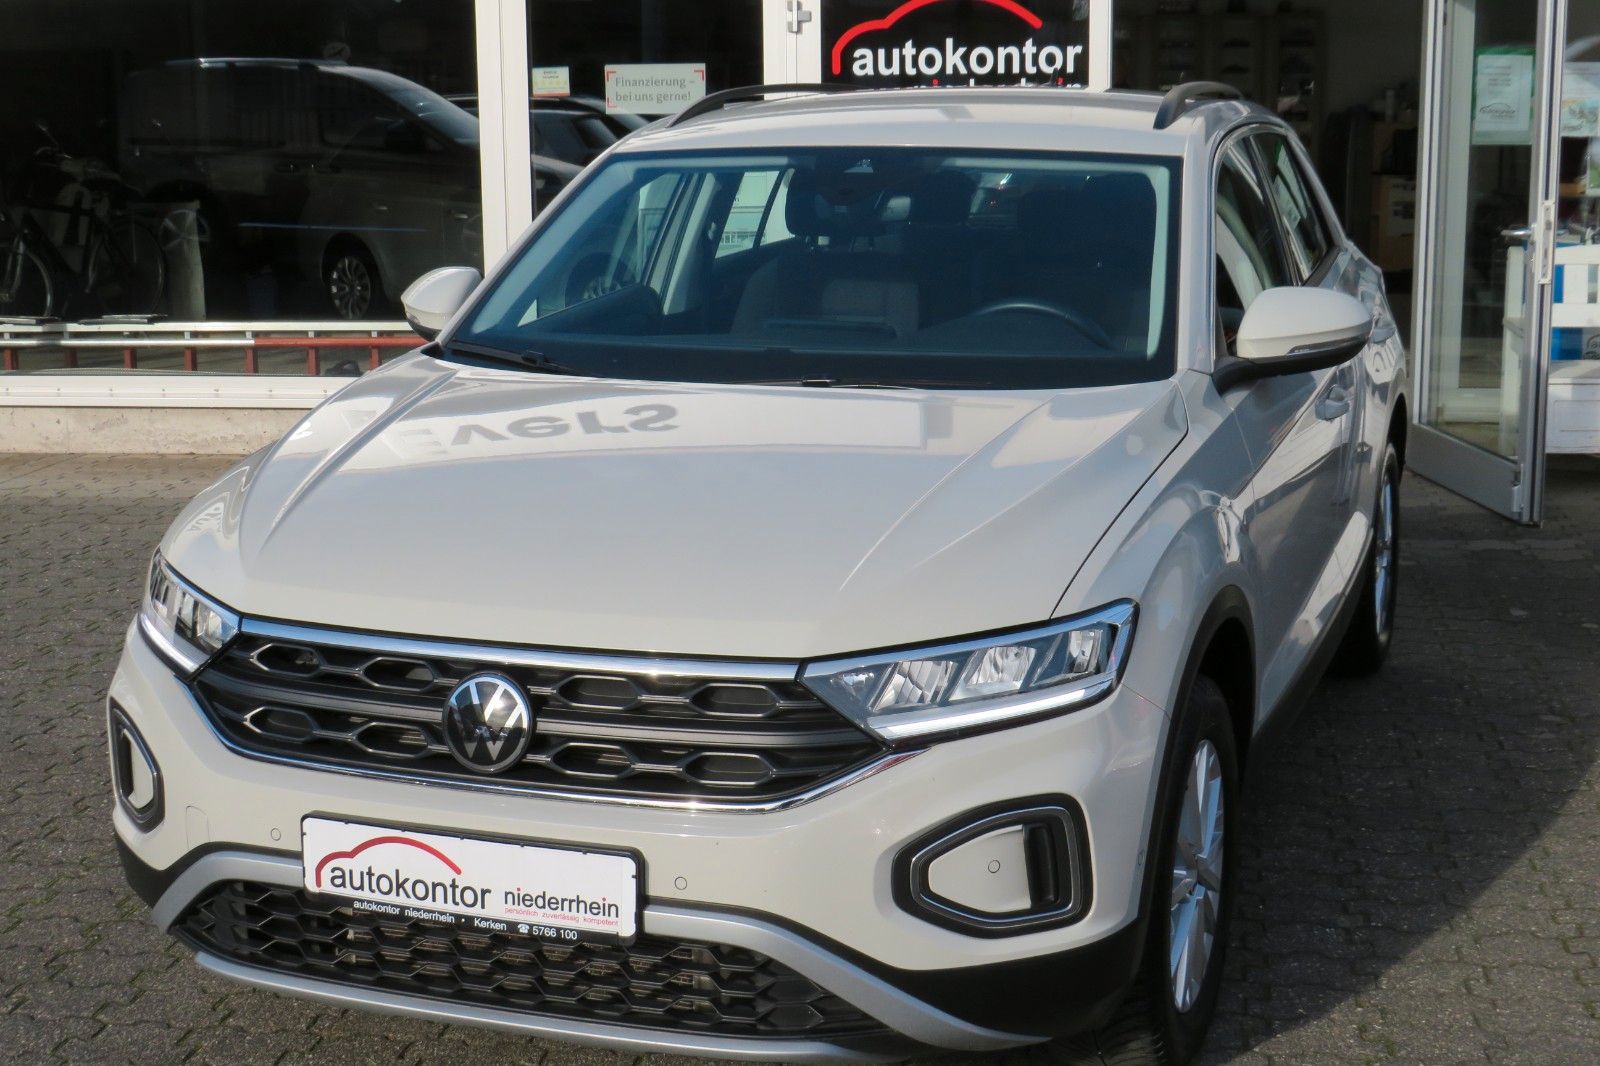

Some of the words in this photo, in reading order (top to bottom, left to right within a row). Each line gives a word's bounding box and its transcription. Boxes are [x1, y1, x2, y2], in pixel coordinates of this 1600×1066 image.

[852, 37, 1083, 76] autokontor
[615, 76, 686, 89] Finanzierung
[615, 91, 633, 101] bei
[635, 93, 655, 101] uns
[656, 92, 691, 104] gerne!
[329, 865, 492, 910] autokontor
[504, 887, 619, 918] niederrhein
[353, 899, 400, 915] autokontor
[405, 907, 455, 924] niederrhein
[474, 917, 507, 931] Kerken
[532, 925, 557, 938] 5766
[560, 929, 578, 940] 100
[542, 911, 580, 924] zuverlässig
[583, 916, 619, 927] kompetent
